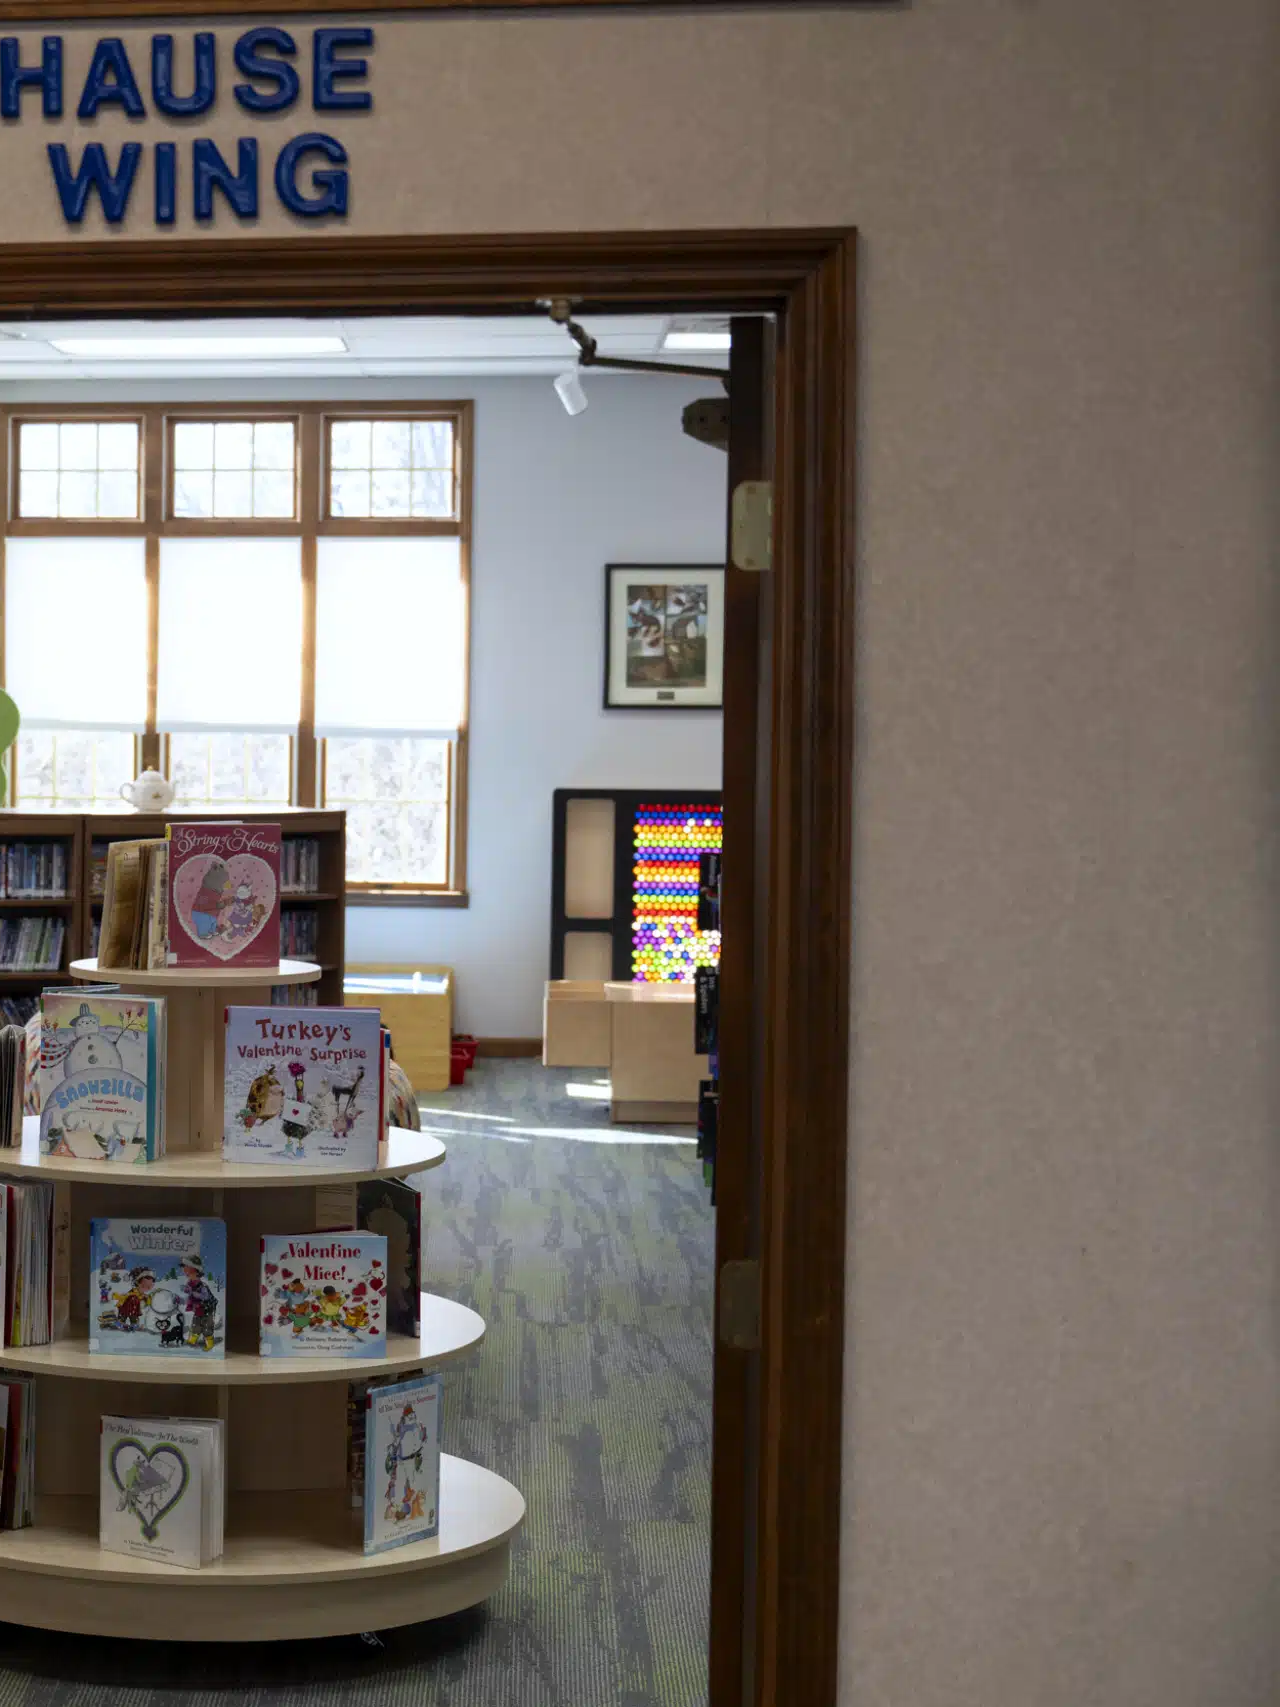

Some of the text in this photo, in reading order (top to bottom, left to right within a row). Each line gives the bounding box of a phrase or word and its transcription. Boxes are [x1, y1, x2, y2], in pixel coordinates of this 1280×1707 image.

[47, 132, 350, 224] WING
[174, 828, 224, 858] String
[226, 827, 280, 854] Hearts
[255, 1018, 352, 1046] Turkey's
[237, 1041, 368, 1065] Valentine Surprise
[131, 1223, 193, 1236] Wonderful
[128, 1234, 196, 1252] Winter
[288, 1241, 361, 1260] Valentine
[303, 1264, 347, 1281] Mice!
